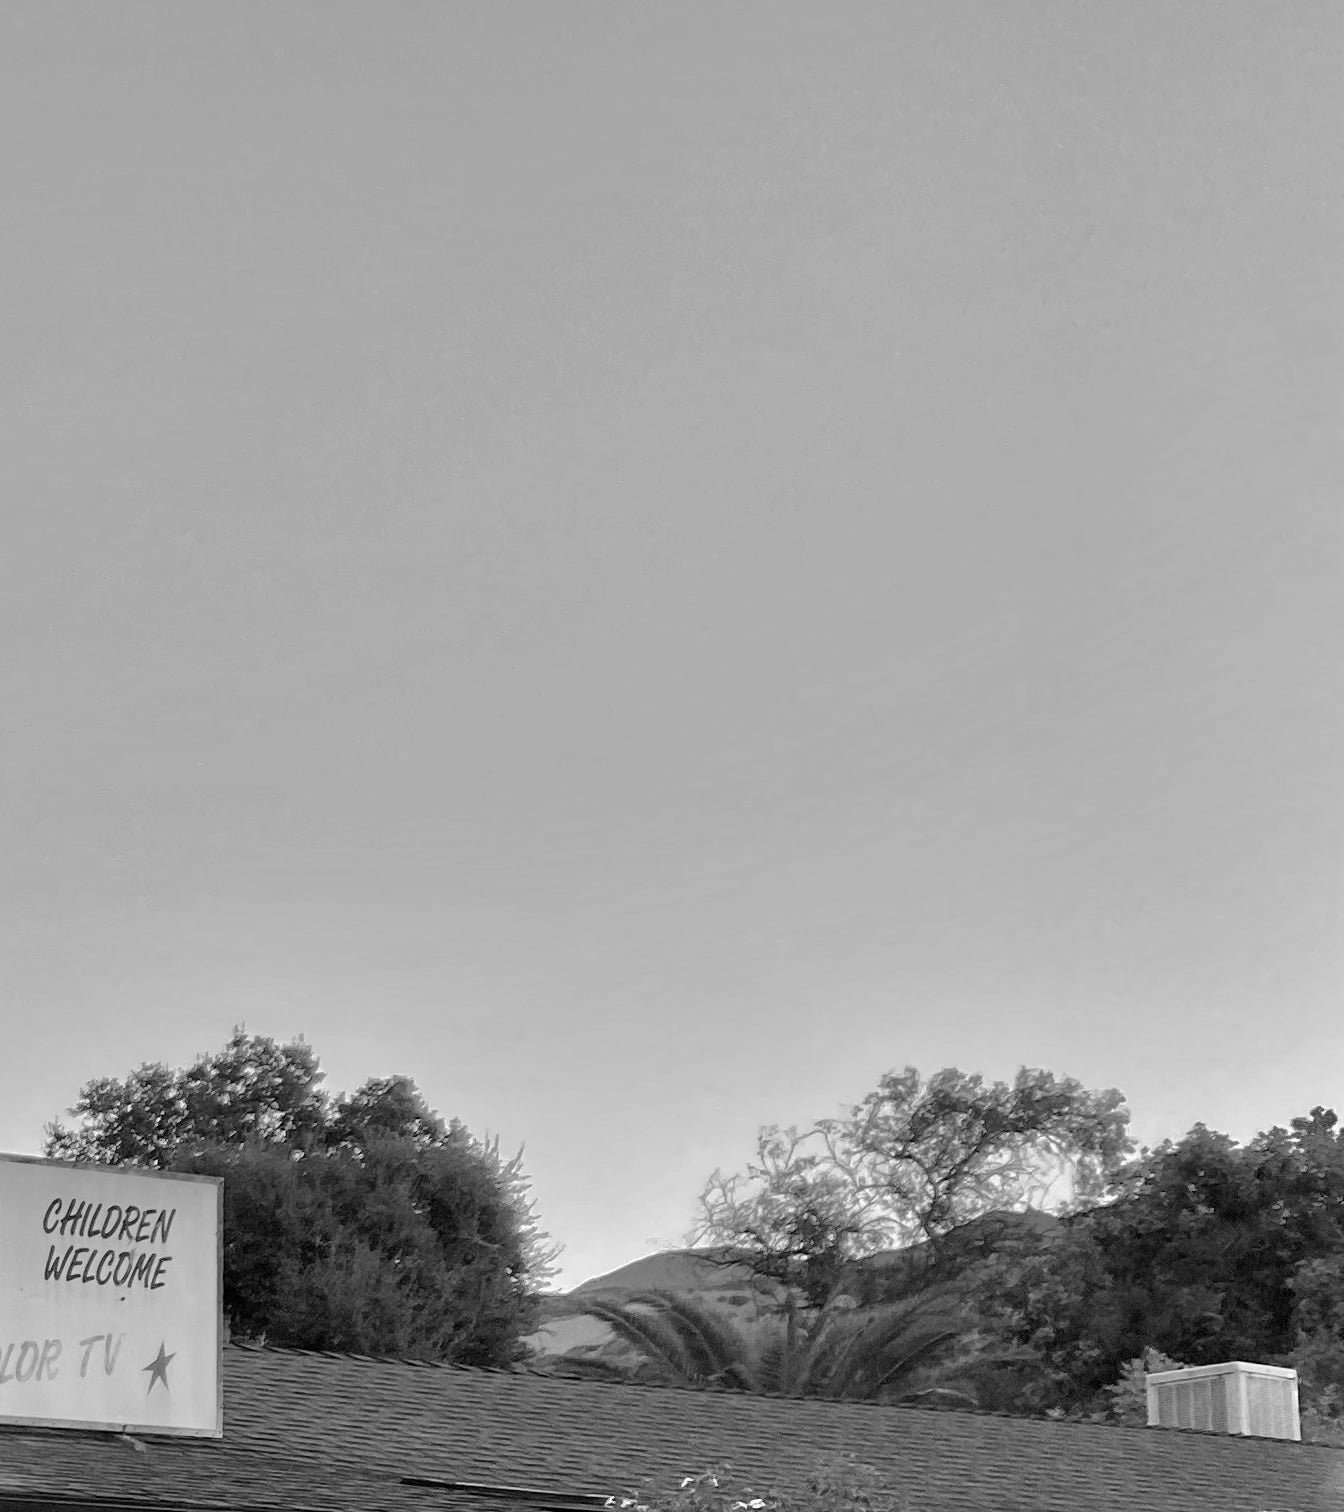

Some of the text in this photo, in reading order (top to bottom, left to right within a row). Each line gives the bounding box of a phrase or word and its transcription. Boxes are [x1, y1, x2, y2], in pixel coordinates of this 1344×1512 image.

[42, 1197, 177, 1245] CHILDREN
[44, 1245, 174, 1291] WELCOME
[79, 1333, 127, 1378] TV
